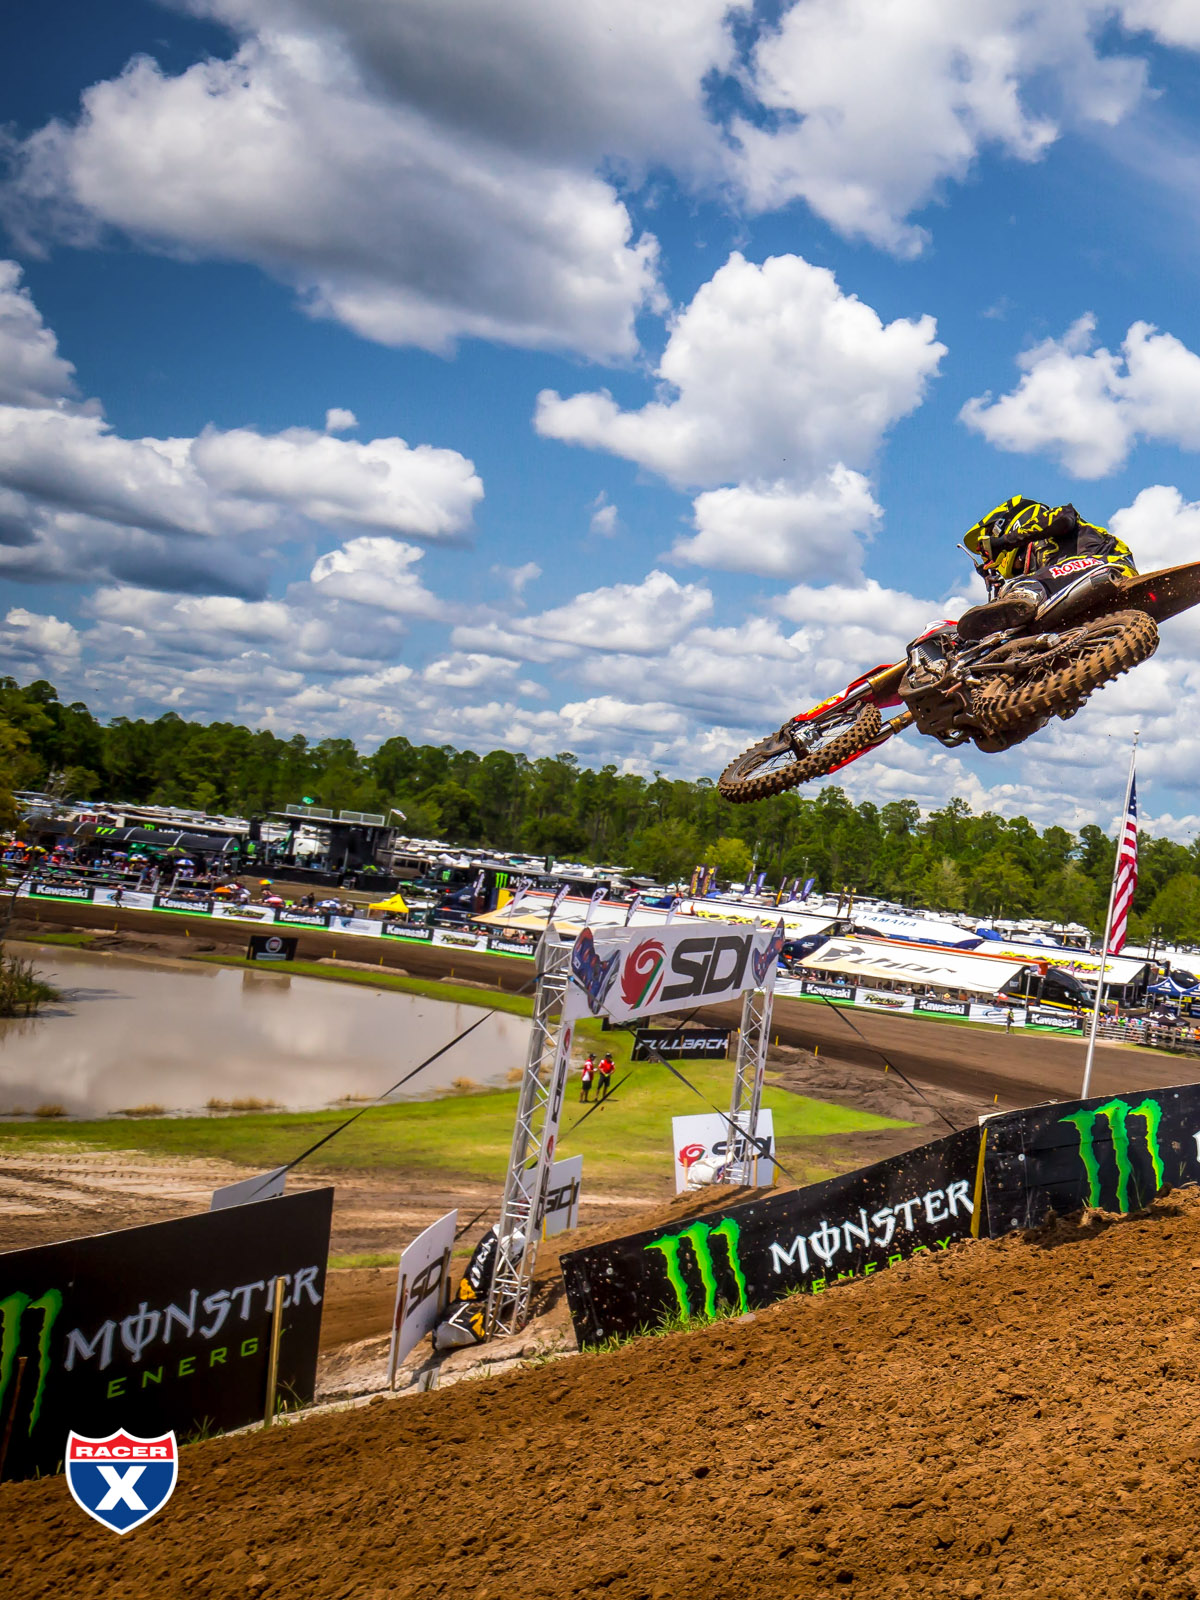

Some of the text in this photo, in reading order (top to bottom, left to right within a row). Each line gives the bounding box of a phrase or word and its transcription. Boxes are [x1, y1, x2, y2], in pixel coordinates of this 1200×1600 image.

[1050, 557, 1104, 578] HONDA
[36, 884, 88, 898] Kawasaki
[159, 897, 209, 911] Kawasaki
[279, 911, 325, 925] Kawasaki
[386, 924, 429, 938] Kawasaki
[491, 939, 533, 954] Kawasaki
[806, 983, 850, 999] Kawasaki
[919, 1000, 965, 1015] Kawasaki
[1031, 1013, 1078, 1029] Kawasaki
[107, 1335, 268, 1399] ENERG
